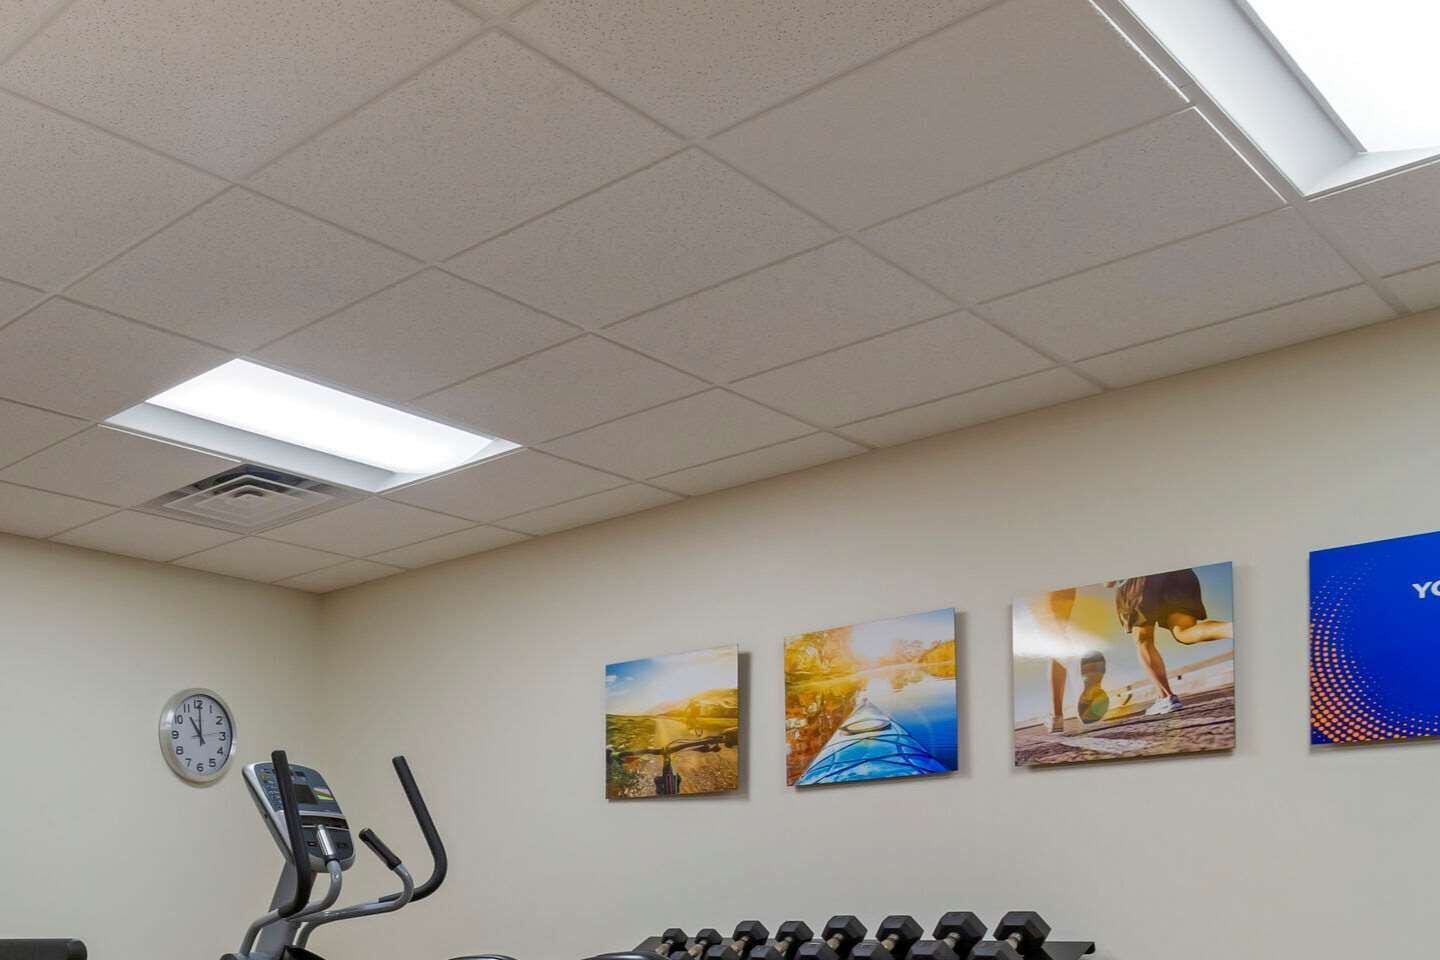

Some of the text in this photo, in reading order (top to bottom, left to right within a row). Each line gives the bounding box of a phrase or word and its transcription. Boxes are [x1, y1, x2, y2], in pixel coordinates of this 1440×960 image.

[184, 704, 190, 713] 11
[194, 700, 203, 709] 12
[175, 714, 183, 725] 10
[215, 716, 224, 725] 2
[171, 730, 179, 739] 9
[219, 732, 227, 741] 3
[176, 746, 184, 755] 8
[217, 747, 224, 755] 4
[185, 758, 191, 767] 7
[209, 758, 216, 767] 5
[196, 763, 204, 772] 6
